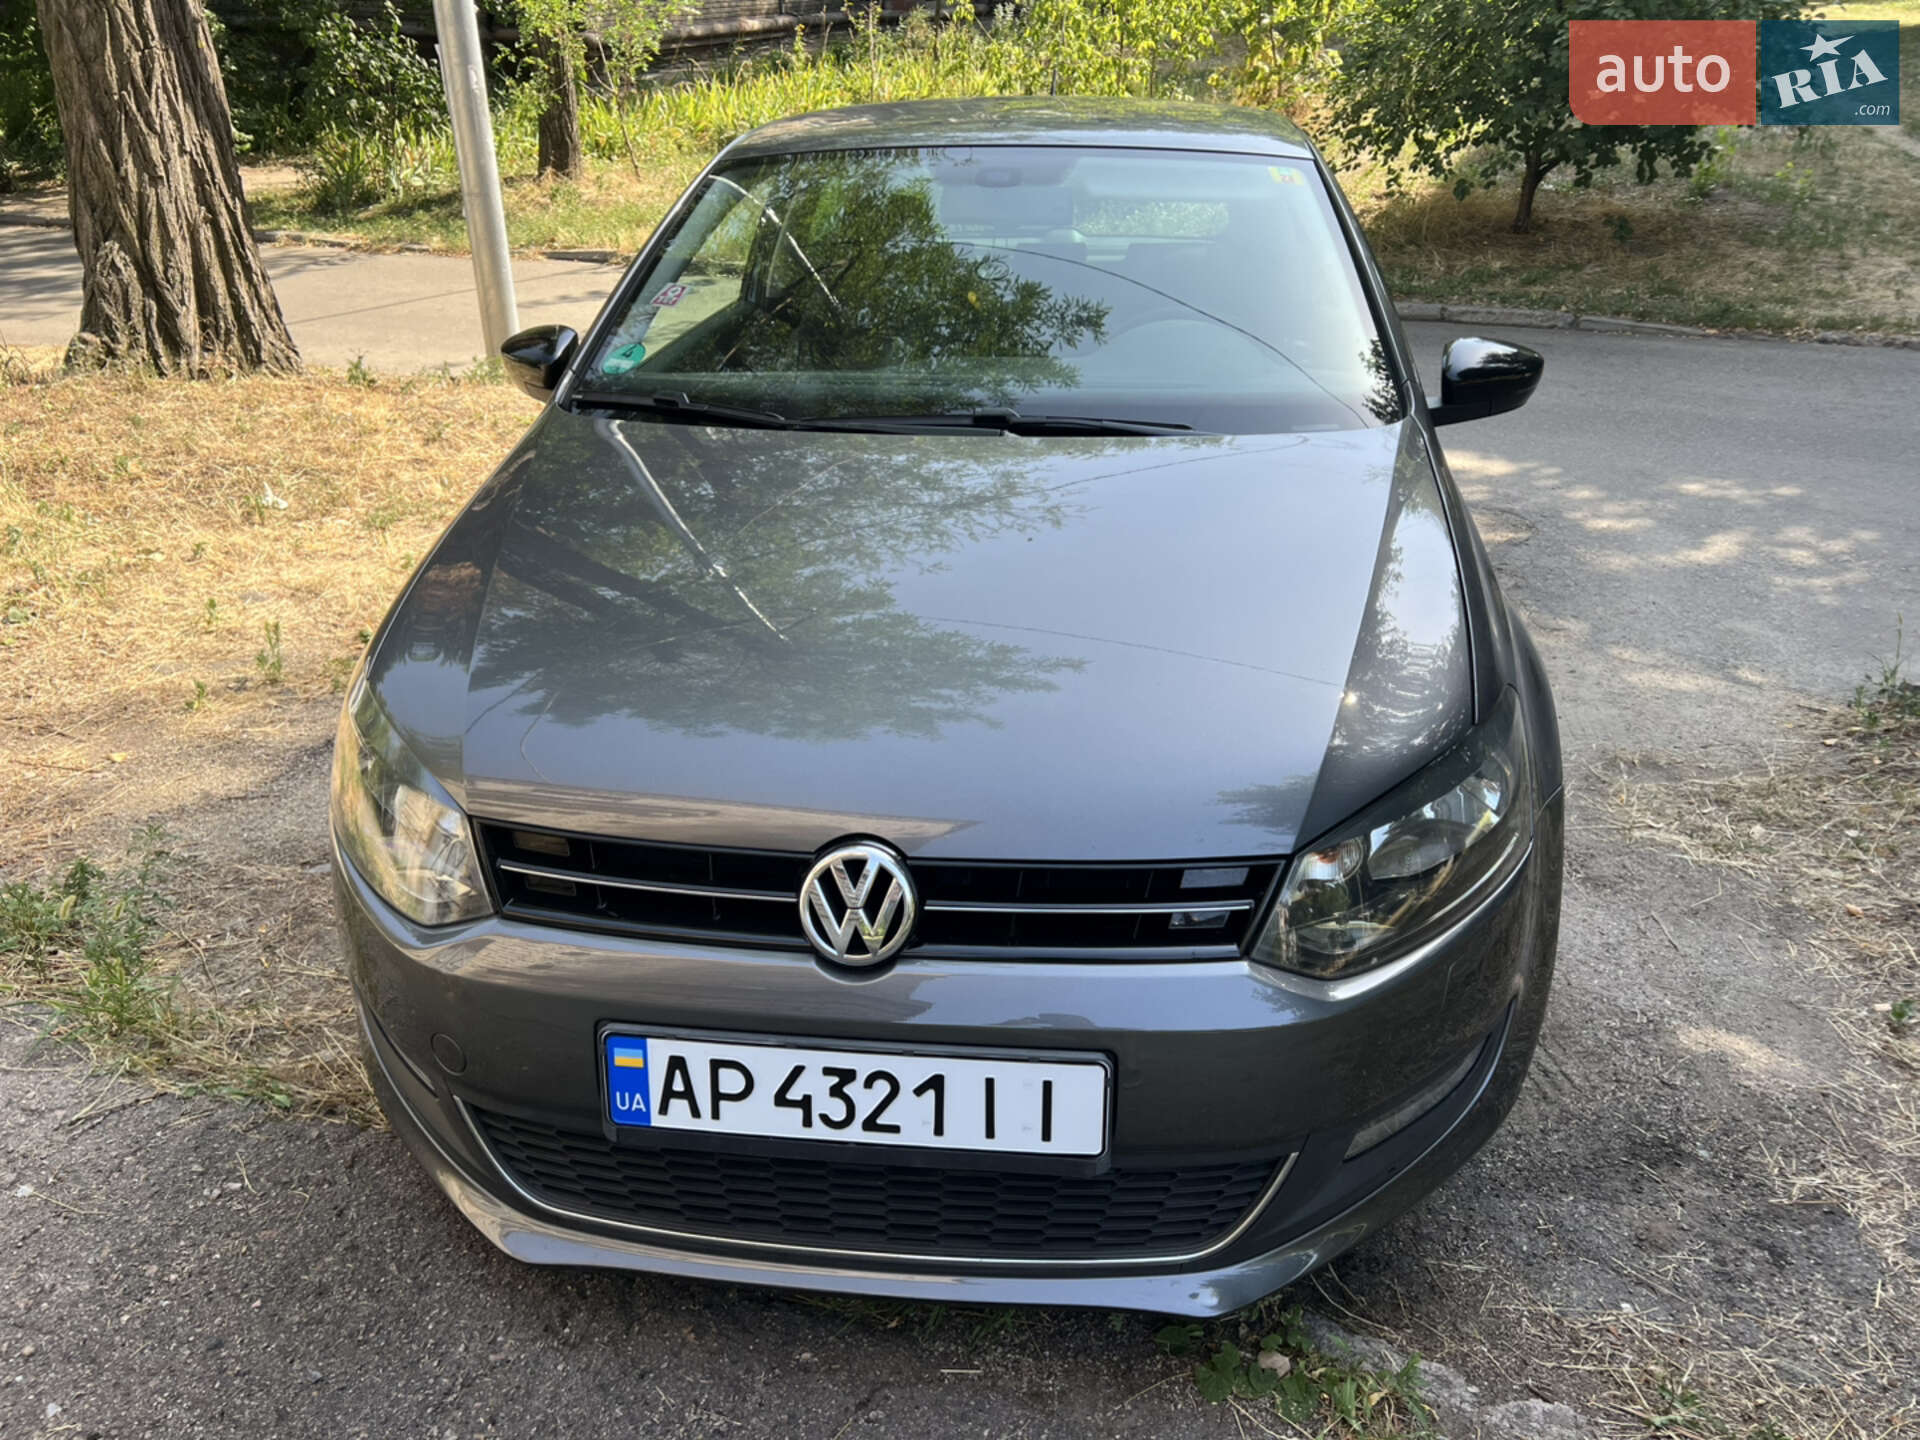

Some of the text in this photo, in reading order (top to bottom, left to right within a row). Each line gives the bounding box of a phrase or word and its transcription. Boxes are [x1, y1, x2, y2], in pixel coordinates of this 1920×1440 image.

[615, 1091, 647, 1112] UA
[658, 1055, 754, 1121] AP
[774, 1065, 945, 1137] 4321
